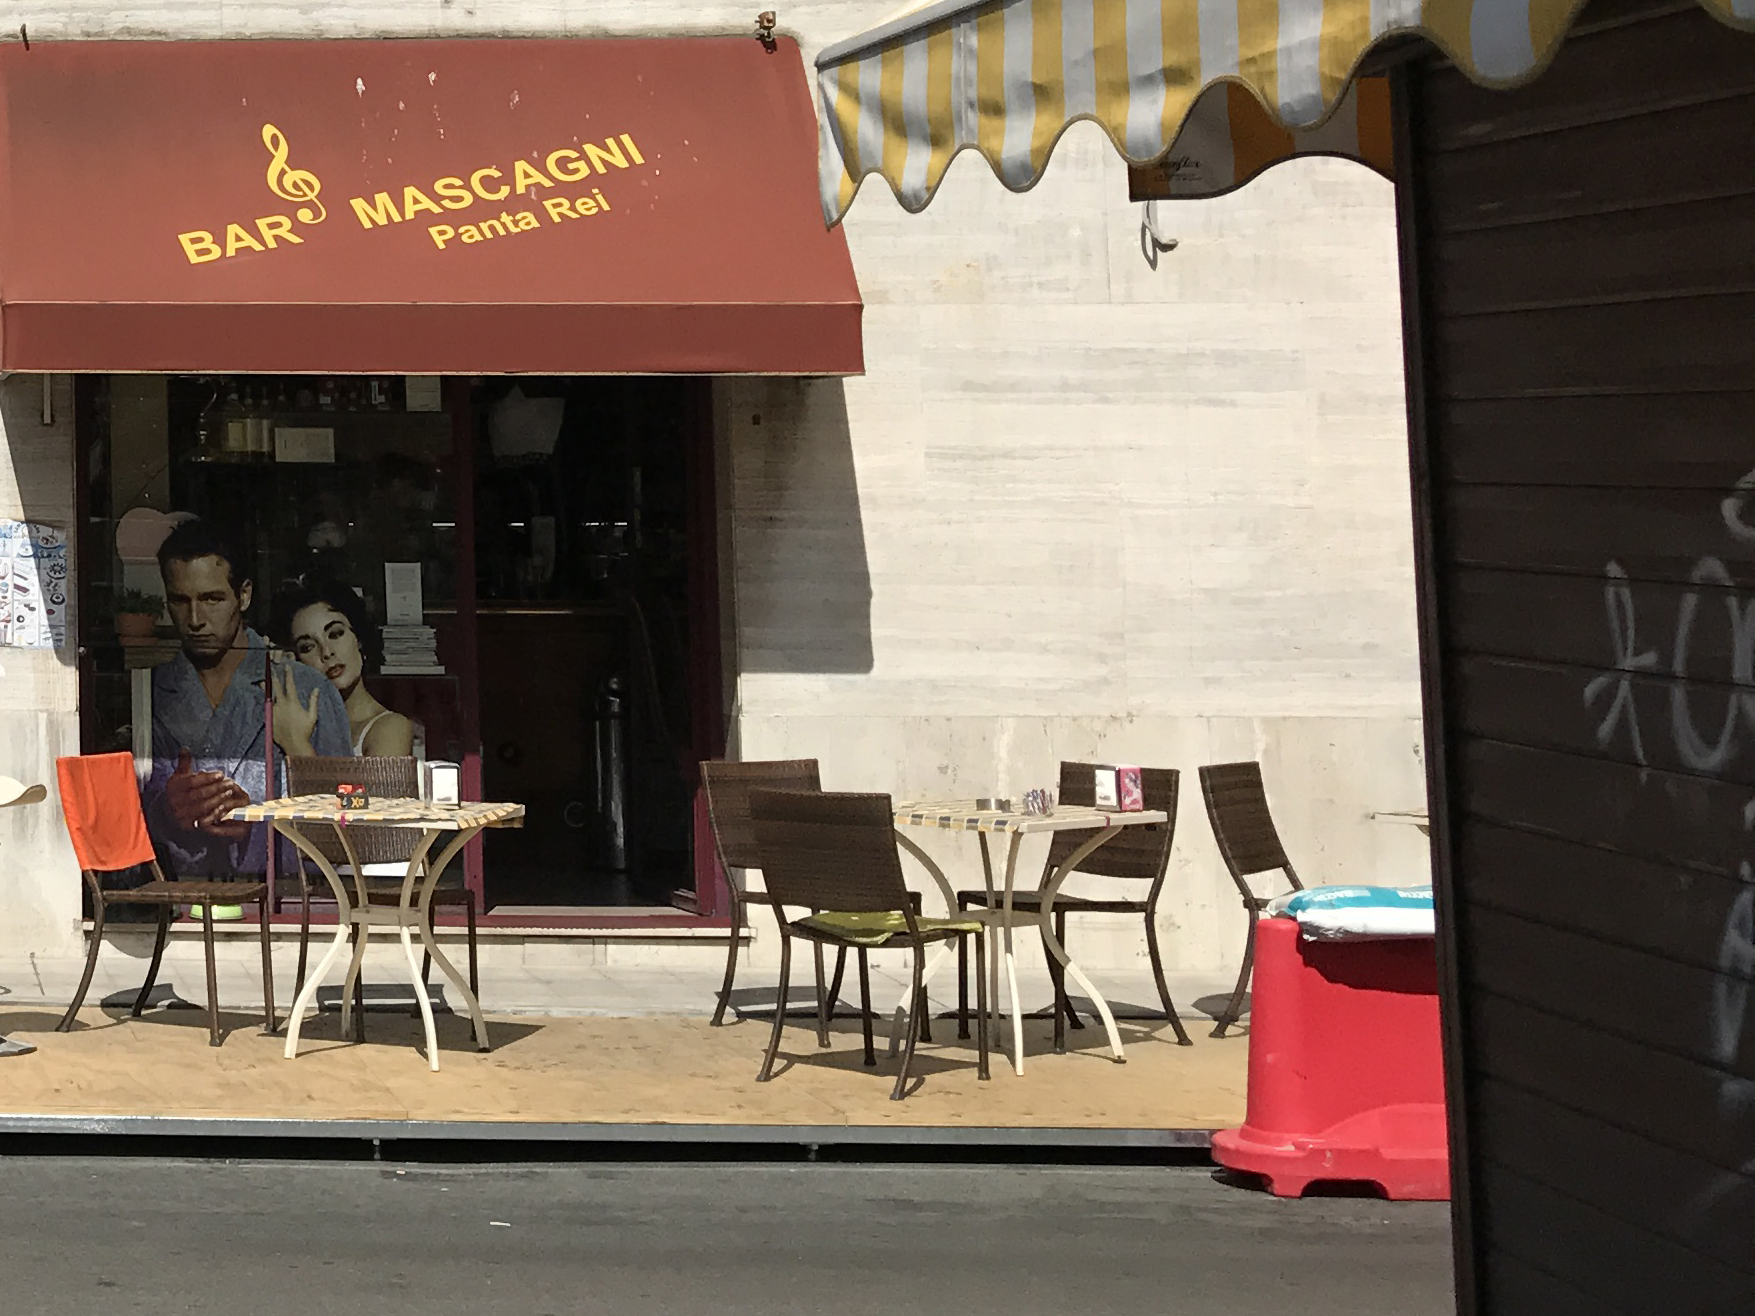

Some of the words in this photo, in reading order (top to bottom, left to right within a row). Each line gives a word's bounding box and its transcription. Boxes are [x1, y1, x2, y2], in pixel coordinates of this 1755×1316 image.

[177, 214, 304, 264] BAR
[349, 133, 645, 229] MASCAGNI
[427, 211, 541, 250] Panta
[542, 187, 612, 223] Rei
